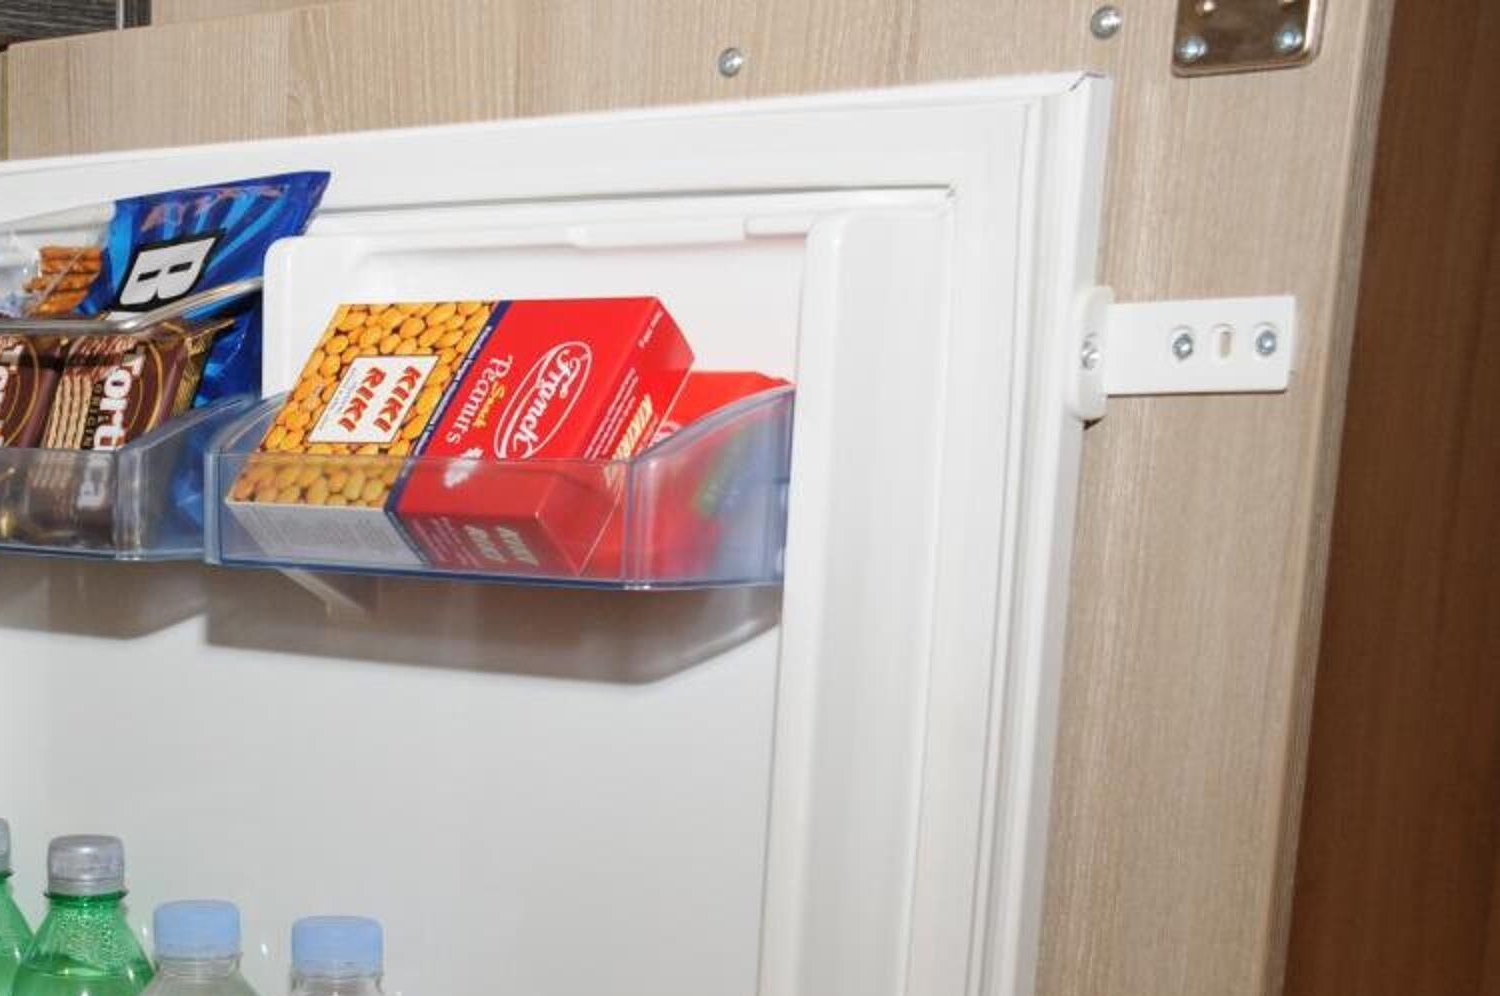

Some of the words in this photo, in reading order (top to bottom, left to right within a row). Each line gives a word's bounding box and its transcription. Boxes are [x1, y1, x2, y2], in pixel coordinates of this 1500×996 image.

[339, 367, 387, 433] RIKI
[373, 366, 421, 433] KIKI
[447, 355, 514, 444] Peanuts
[513, 349, 581, 458] Franck
